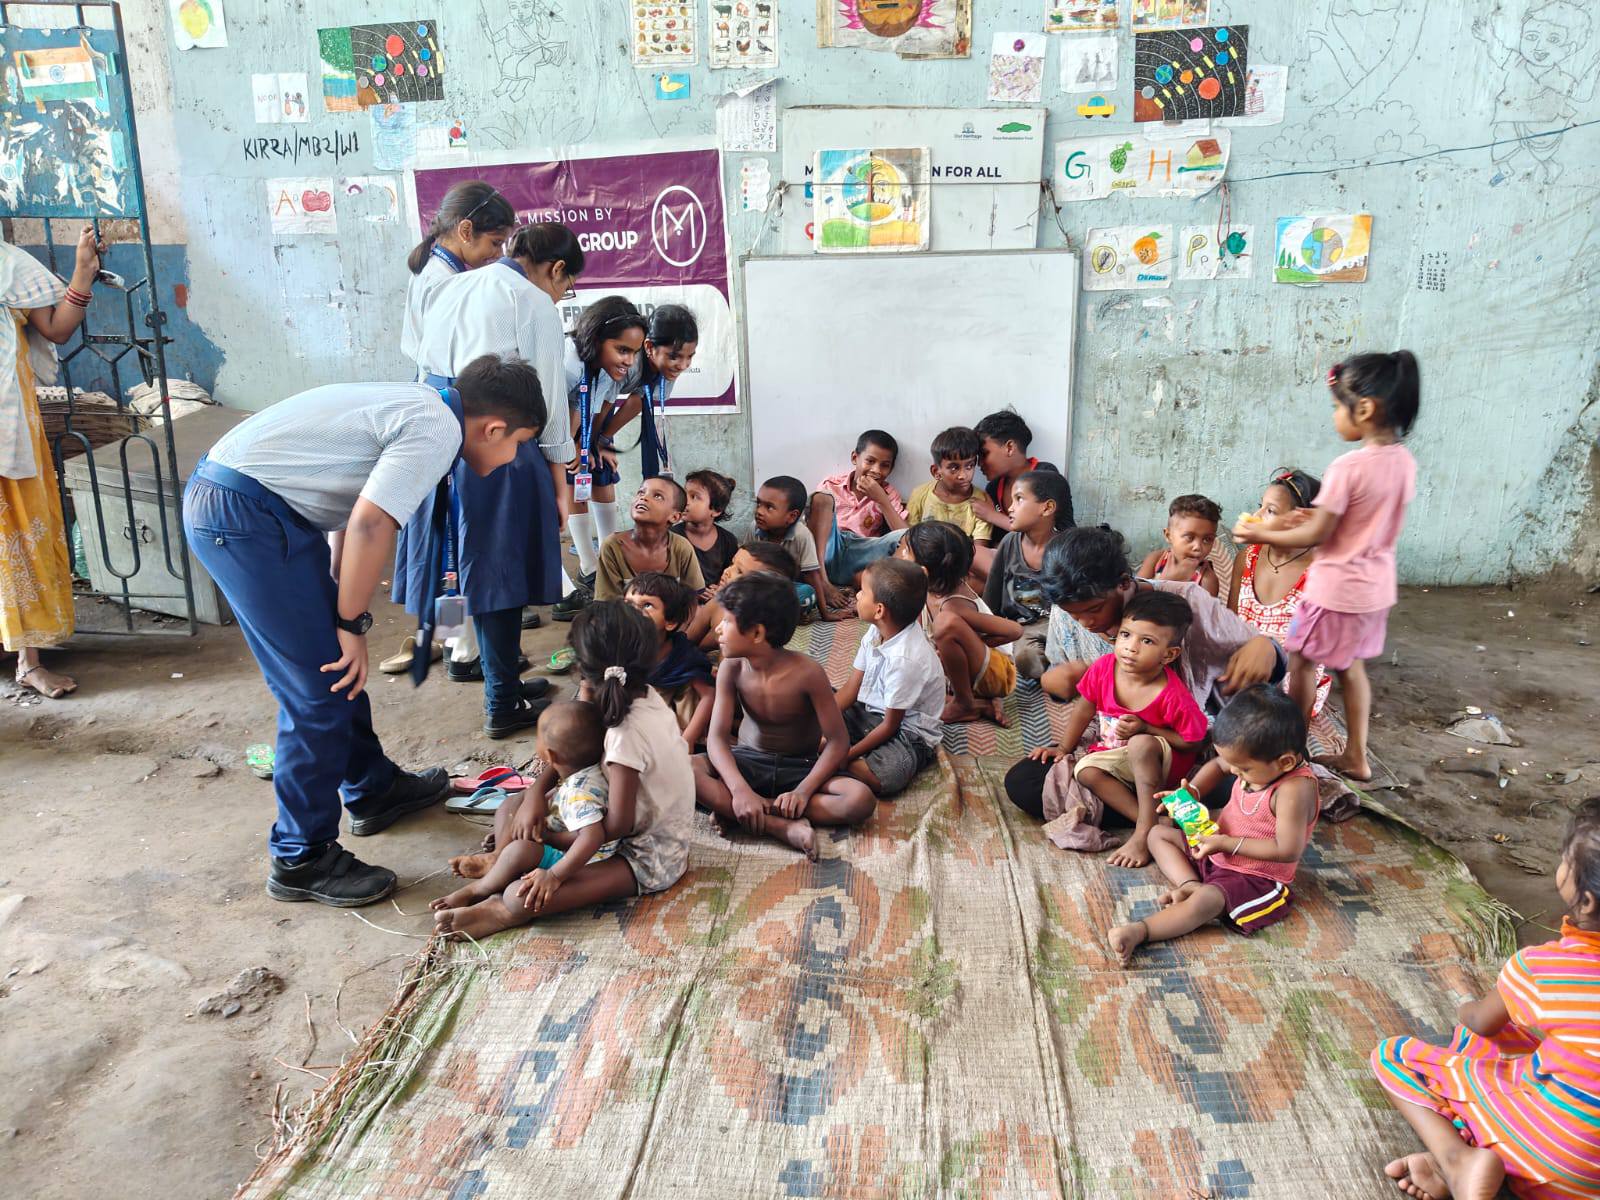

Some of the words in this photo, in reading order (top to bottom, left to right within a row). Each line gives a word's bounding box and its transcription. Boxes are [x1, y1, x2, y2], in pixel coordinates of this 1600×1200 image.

[945, 166, 973, 178] FOR
[976, 166, 1003, 178] ALL
[1065, 150, 1092, 180] G
[1147, 149, 1173, 182] H
[275, 189, 297, 217] A
[527, 208, 589, 224] MISSION
[595, 207, 613, 221] BY
[577, 230, 639, 252] GROUP
